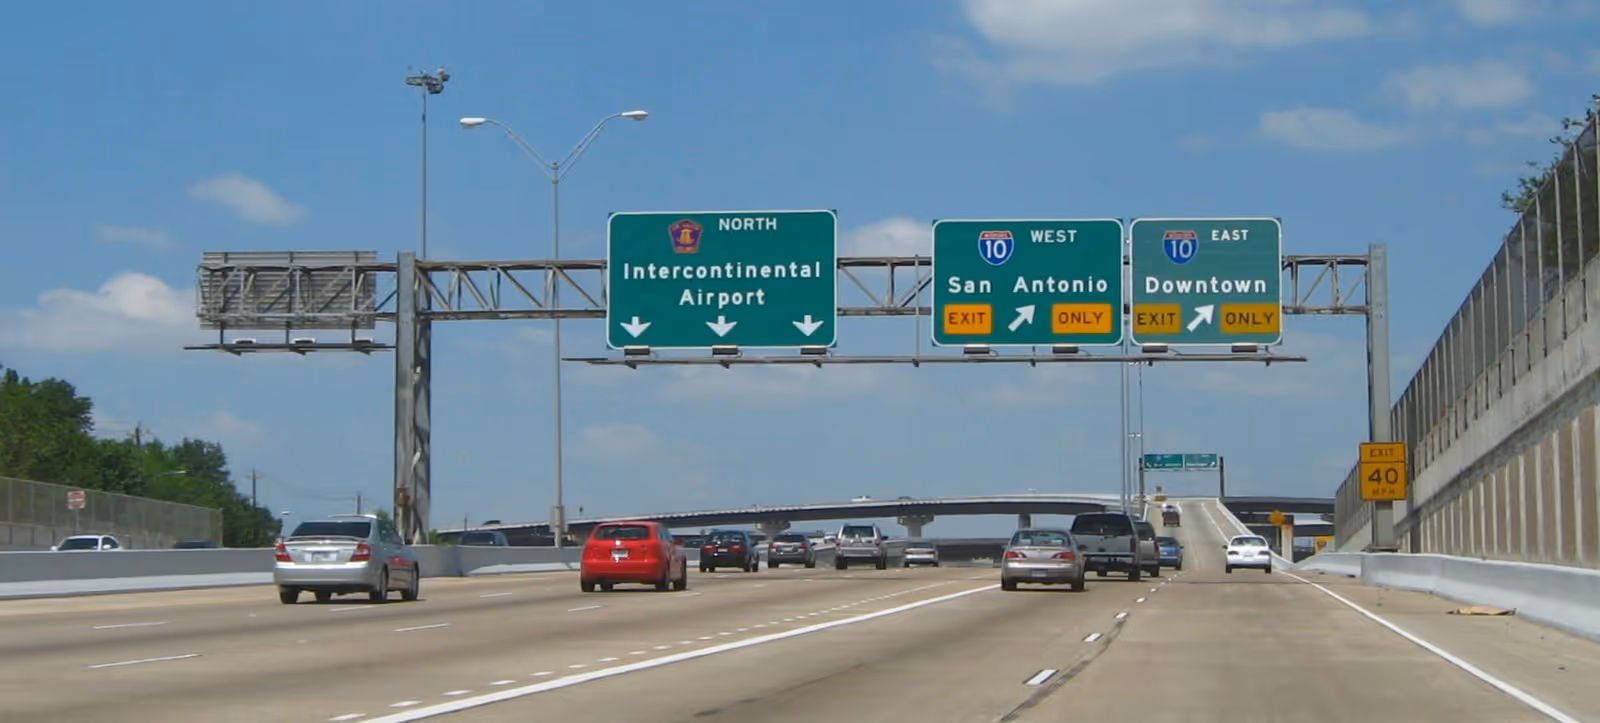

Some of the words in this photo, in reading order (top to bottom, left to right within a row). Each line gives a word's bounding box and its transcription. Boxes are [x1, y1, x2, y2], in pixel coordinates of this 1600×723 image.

[719, 218, 777, 231] NORTH
[1030, 229, 1078, 243] WEST
[1211, 229, 1249, 241] EAST
[985, 240, 1007, 259] 10
[1171, 240, 1193, 259] 10
[624, 261, 821, 280] Intercontinental
[948, 276, 992, 293] San
[1013, 275, 1108, 293] Antonio
[1145, 276, 1266, 294] Downtown
[679, 288, 765, 309] Airport
[949, 312, 986, 325] EXIT
[1058, 311, 1103, 324] ONLY
[1137, 313, 1176, 326] EXIT
[1225, 312, 1274, 325] ONLY
[1370, 448, 1394, 458] EXIT
[1368, 468, 1399, 485] 40
